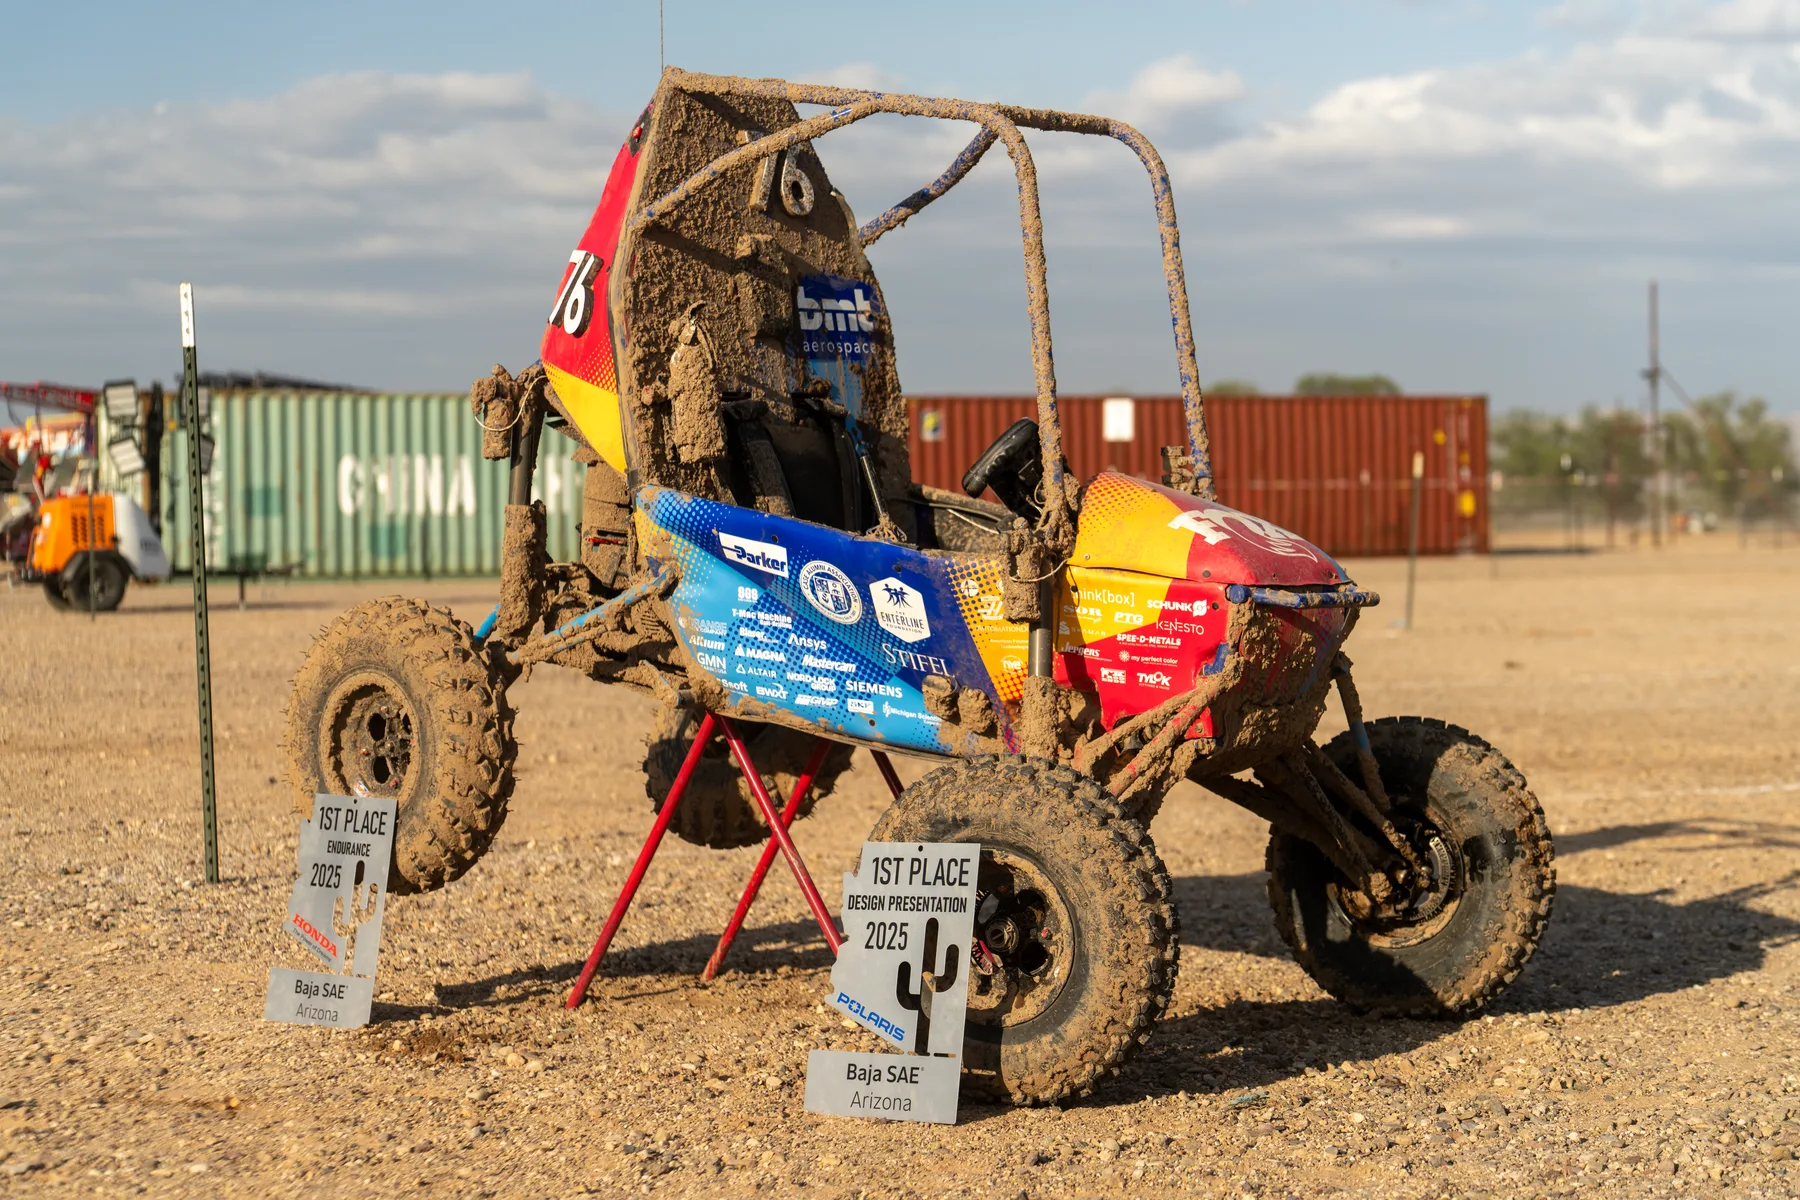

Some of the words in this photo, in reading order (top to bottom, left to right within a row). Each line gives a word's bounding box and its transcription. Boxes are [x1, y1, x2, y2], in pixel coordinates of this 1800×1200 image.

[547, 249, 598, 336] 76
[797, 286, 873, 332] bmt
[803, 341, 877, 356] aerospace
[734, 545, 787, 572] Parker
[802, 574, 810, 590] CASE
[806, 564, 826, 576] ALUMNI
[827, 567, 858, 603] ASSOCIATION
[1147, 600, 1193, 612] SCHUNK
[880, 612, 925, 630] ENTERLINE
[1114, 612, 1144, 624] PTG
[886, 623, 923, 634] FOUNDATION
[788, 633, 827, 651] Ansys
[1116, 633, 1182, 646] SPEE-D-METALS
[746, 648, 787, 662] MAGNA
[1061, 642, 1100, 657] Jergens
[697, 652, 727, 670] GMN
[801, 654, 856, 673] Mastercam
[882, 643, 955, 678] STIFEL
[747, 667, 777, 678] ALTAIR
[786, 672, 836, 686] NORD-LOCK
[1136, 671, 1172, 687] TYLOK
[756, 683, 788, 699] BWXT
[845, 680, 903, 698] SIEMENS
[319, 806, 341, 831] 1ST
[343, 808, 388, 836] PLACE
[326, 840, 371, 857] ENDURANCE
[310, 862, 342, 889] 2025
[872, 856, 904, 885] 1ST
[908, 857, 971, 887] PLACE
[847, 894, 885, 912] DESIGN
[888, 895, 967, 913] PRESENTATION
[292, 913, 338, 958] HONDA
[864, 921, 909, 951] 2025
[294, 979, 319, 999] Baja
[295, 1002, 338, 1022] Arizona
[837, 992, 905, 1042] POLARIS
[846, 1062, 882, 1086] Baja
[849, 1090, 912, 1112] Arizona
